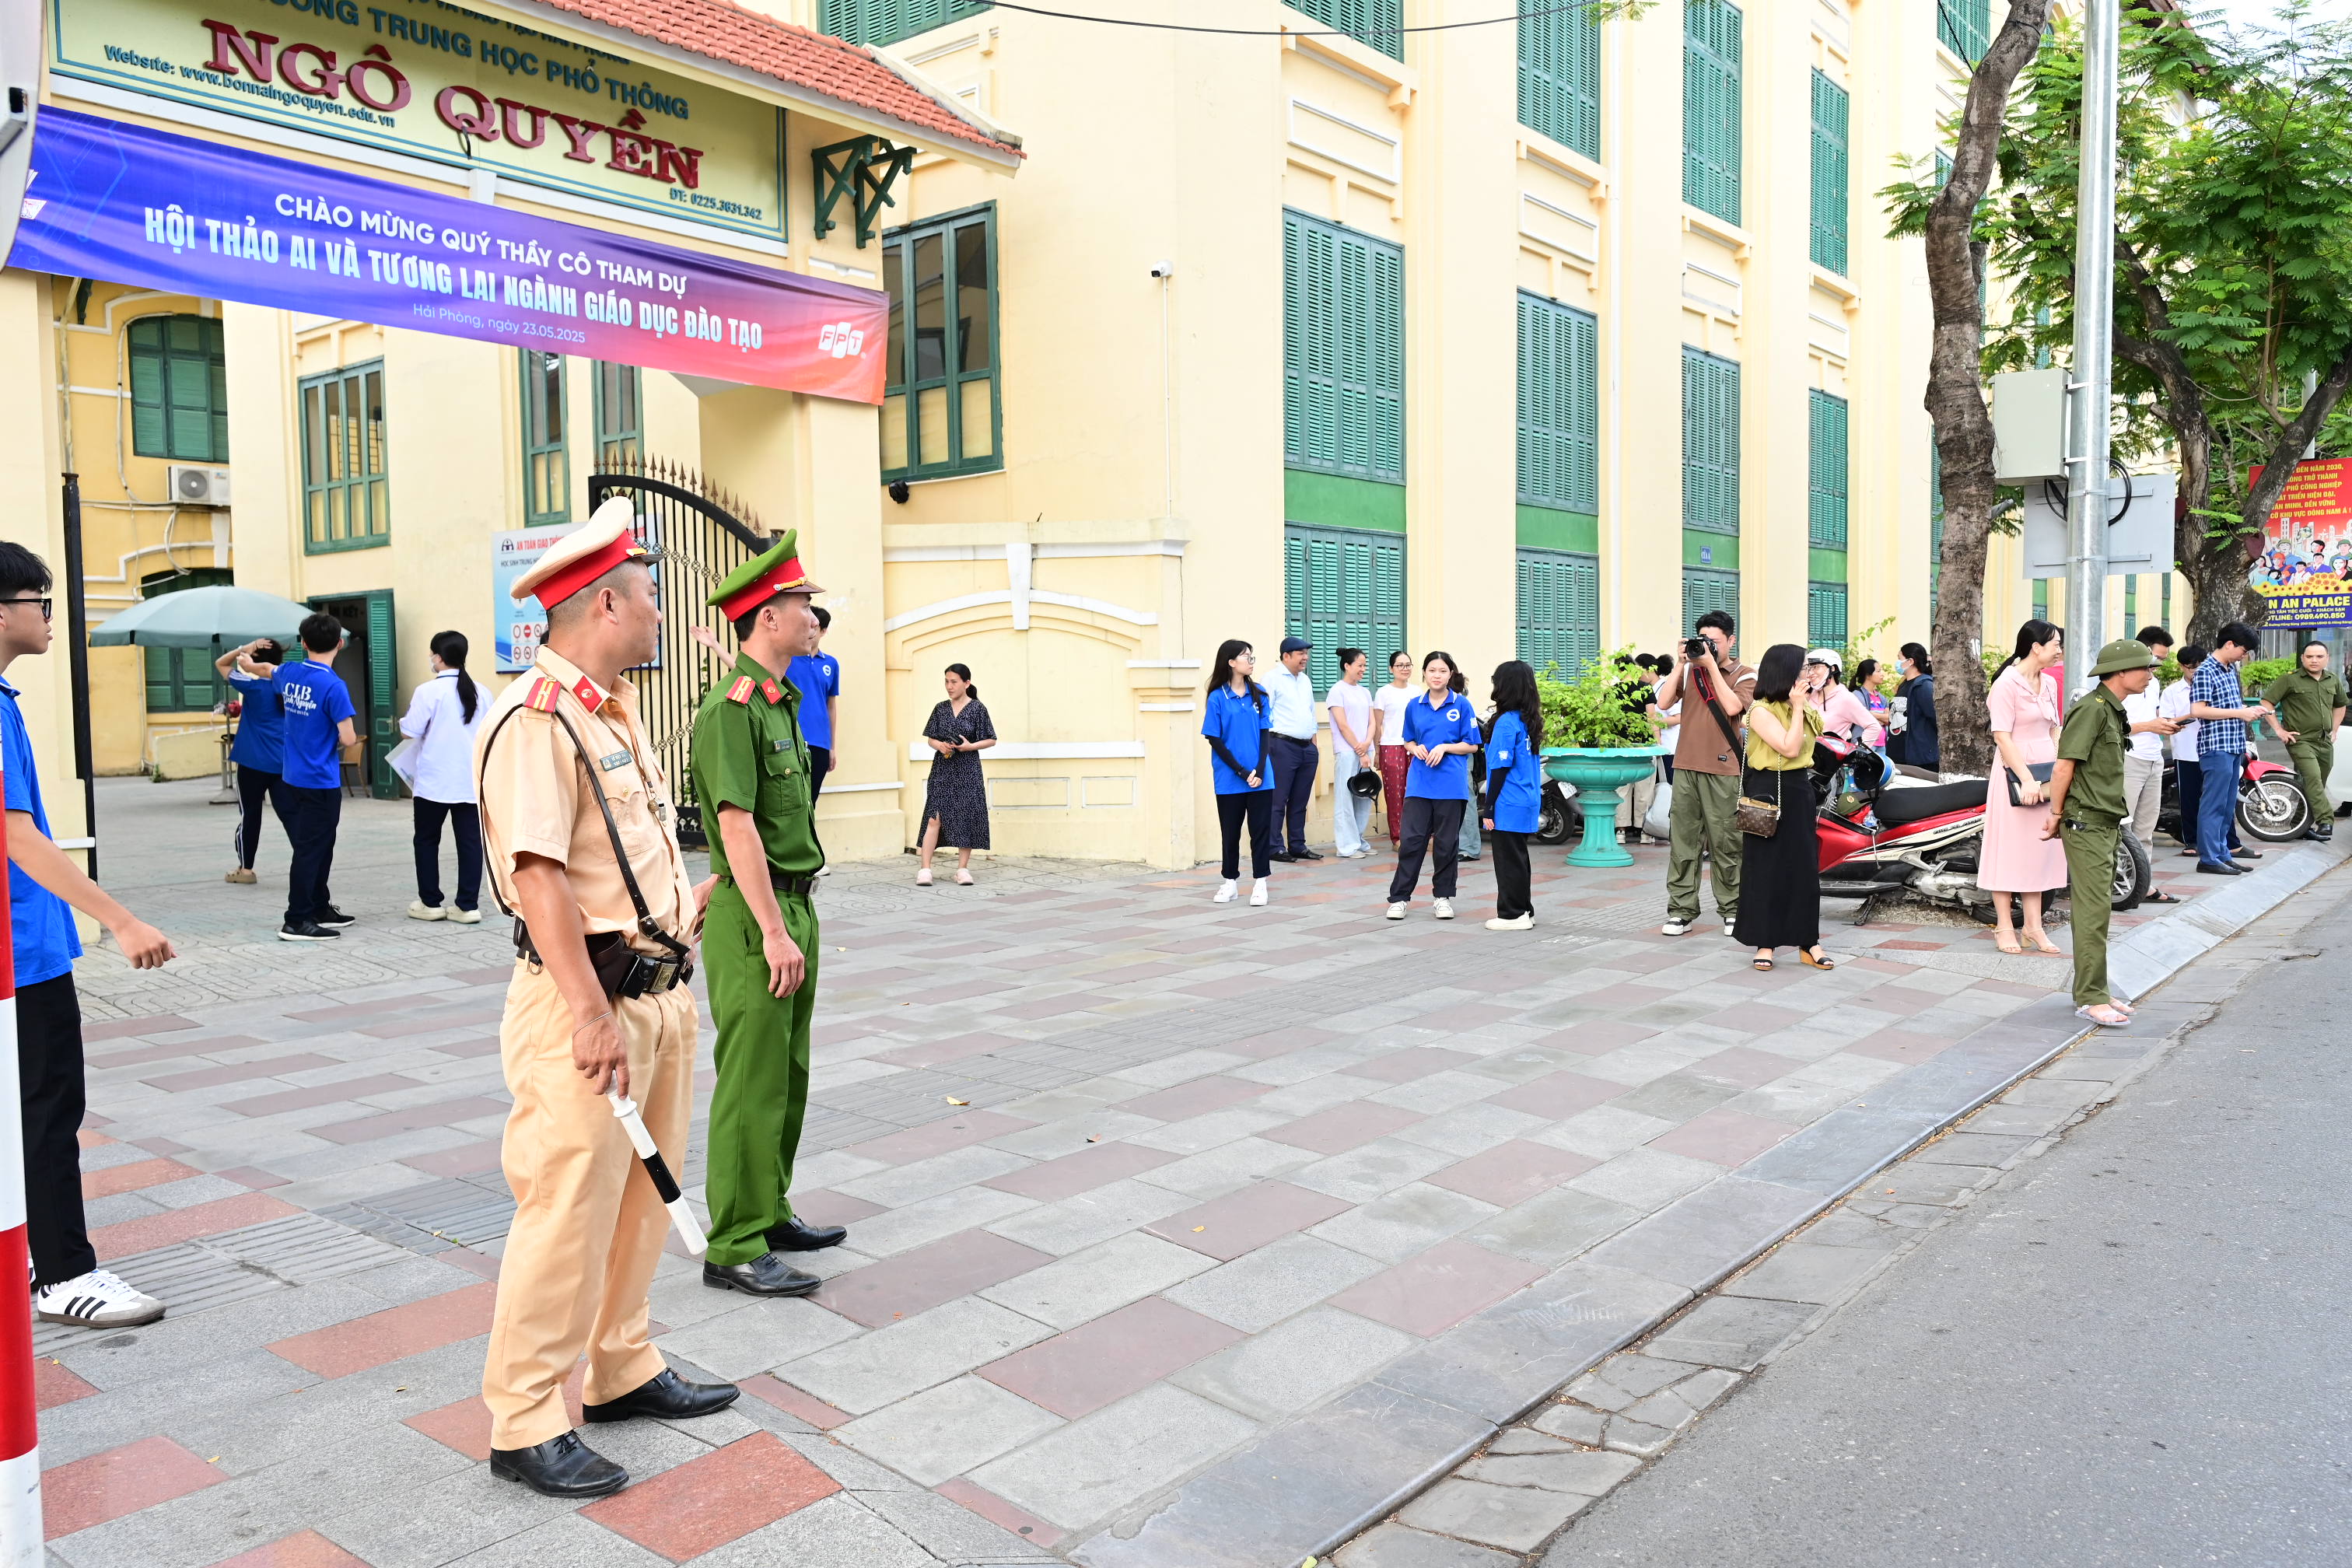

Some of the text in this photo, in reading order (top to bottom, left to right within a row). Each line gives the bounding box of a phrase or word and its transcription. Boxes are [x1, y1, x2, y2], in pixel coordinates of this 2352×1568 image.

[104, 44, 175, 75] Website:
[368, 7, 471, 57] TRUNG
[481, 40, 539, 75] HỌC
[547, 58, 600, 93] PHỔ
[606, 82, 688, 119] THÔNG
[202, 19, 411, 111] NGÔ
[435, 85, 704, 189] QUYỀN
[145, 204, 762, 352] HỘI THẢO AI VÀ TƯƠNG LAI NGÀNH GIÁO DỤC ĐÀO TẠO
[275, 194, 687, 299] CHÀO MỪNG QUÝ THẦY CÔ THAM DỰ
[413, 303, 586, 343] Hải Phòng, ngày 23.05.2025
[2281, 598, 2299, 608] AN
[2303, 596, 2350, 607] PALACE
[285, 682, 311, 701] CLB
